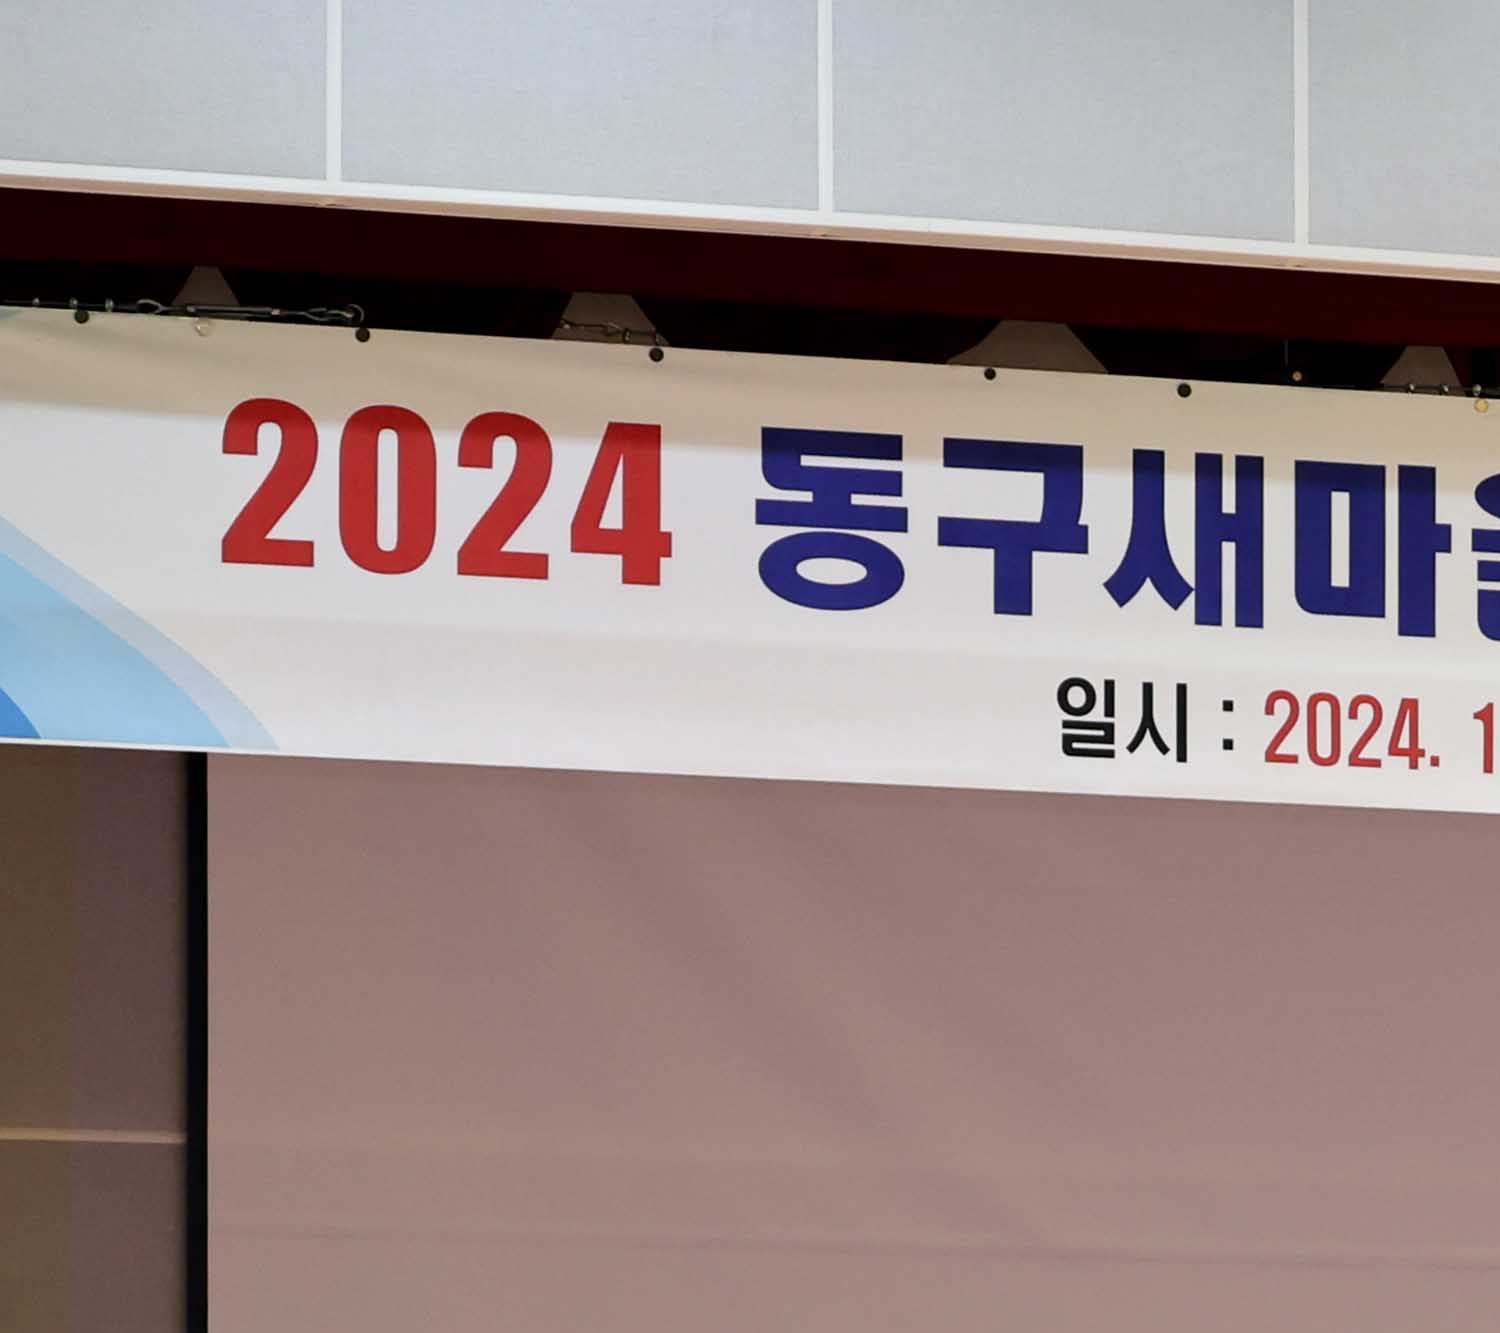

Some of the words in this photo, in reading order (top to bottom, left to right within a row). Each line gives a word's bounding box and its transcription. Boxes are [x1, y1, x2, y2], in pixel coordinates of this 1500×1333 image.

[221, 396, 673, 586] 2024
[1055, 676, 1189, 764] 일시
[1264, 689, 1441, 770] 2024.
